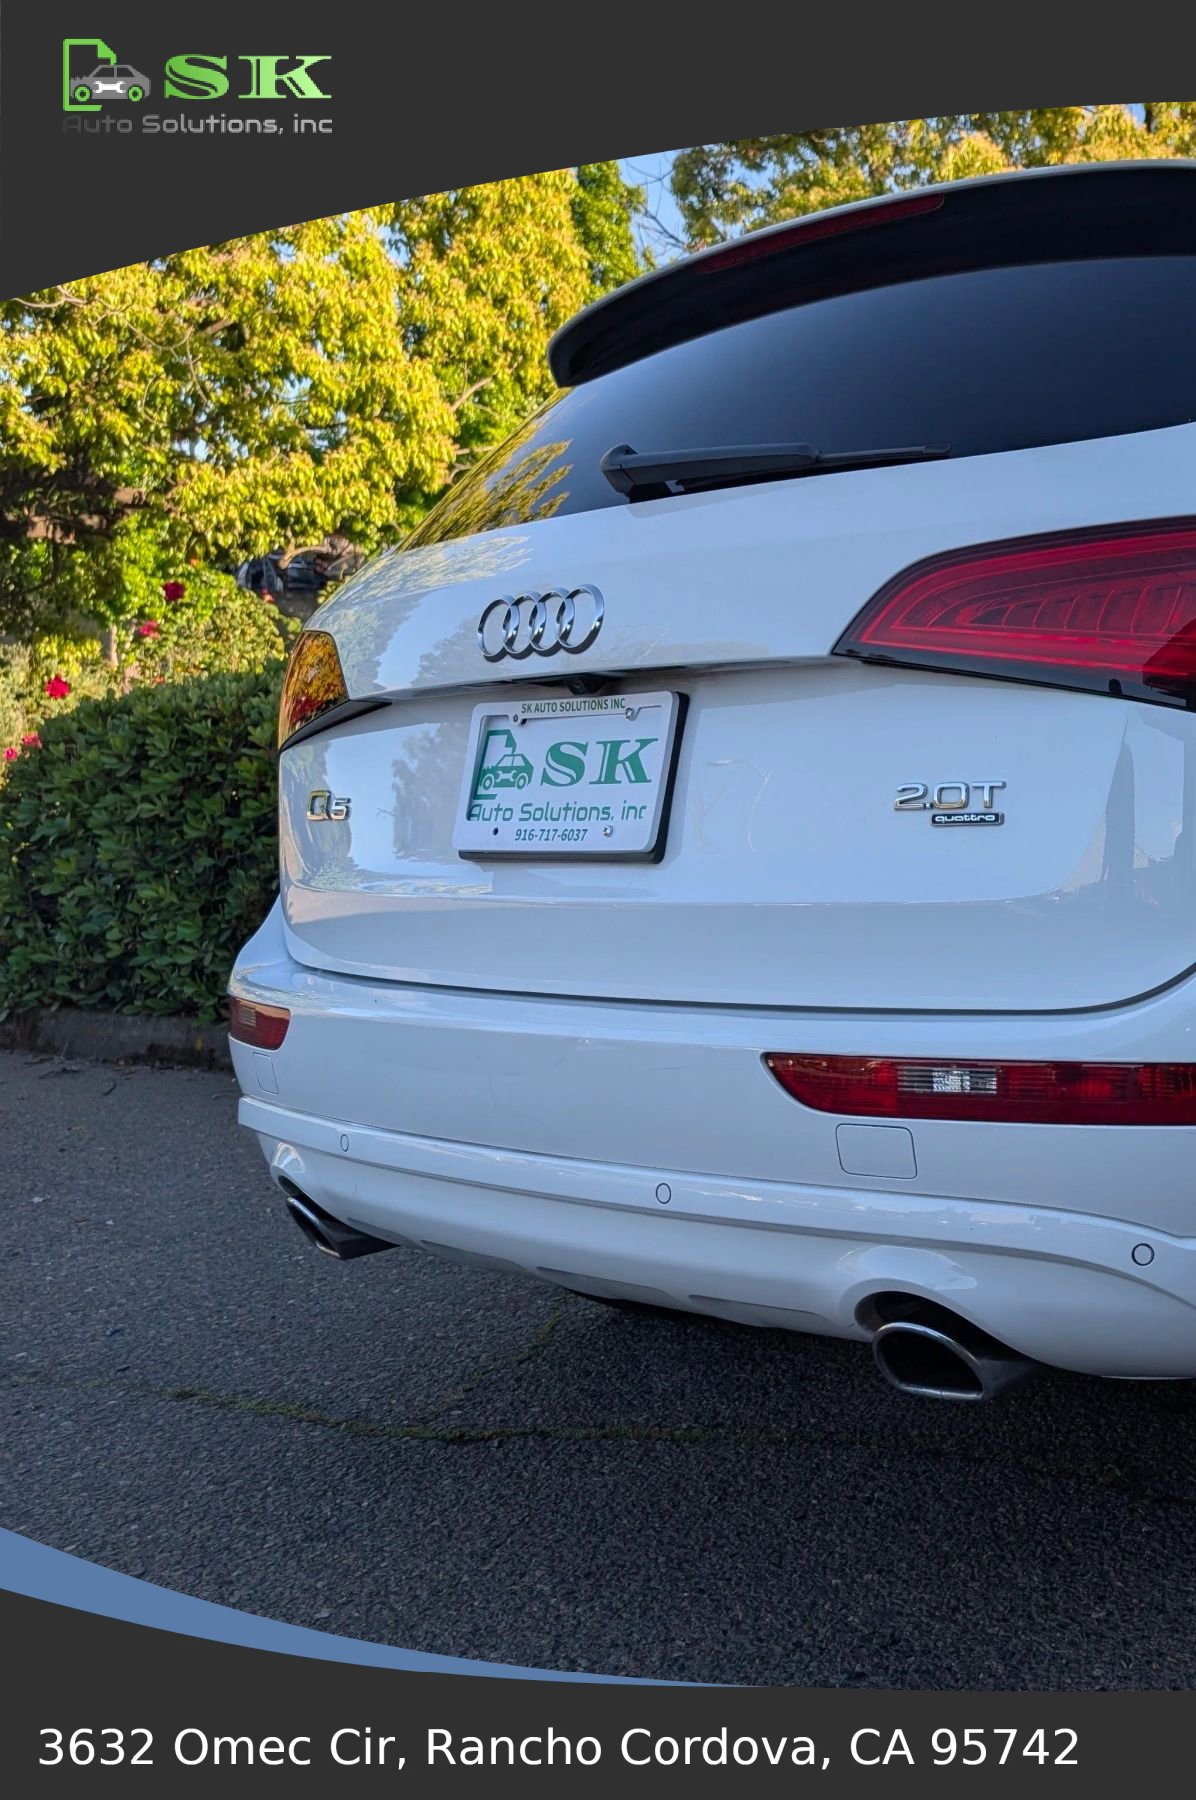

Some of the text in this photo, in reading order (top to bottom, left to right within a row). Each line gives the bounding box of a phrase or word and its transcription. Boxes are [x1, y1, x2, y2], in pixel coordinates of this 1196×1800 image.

[521, 697, 626, 714] SK AUTO SOLUTIONS INC
[540, 738, 659, 787] SK
[306, 789, 352, 821] Q5
[894, 781, 1006, 811] 2.0T
[468, 803, 514, 822] Auto
[934, 813, 997, 824] quattro
[514, 828, 589, 842] 916-717-6037
